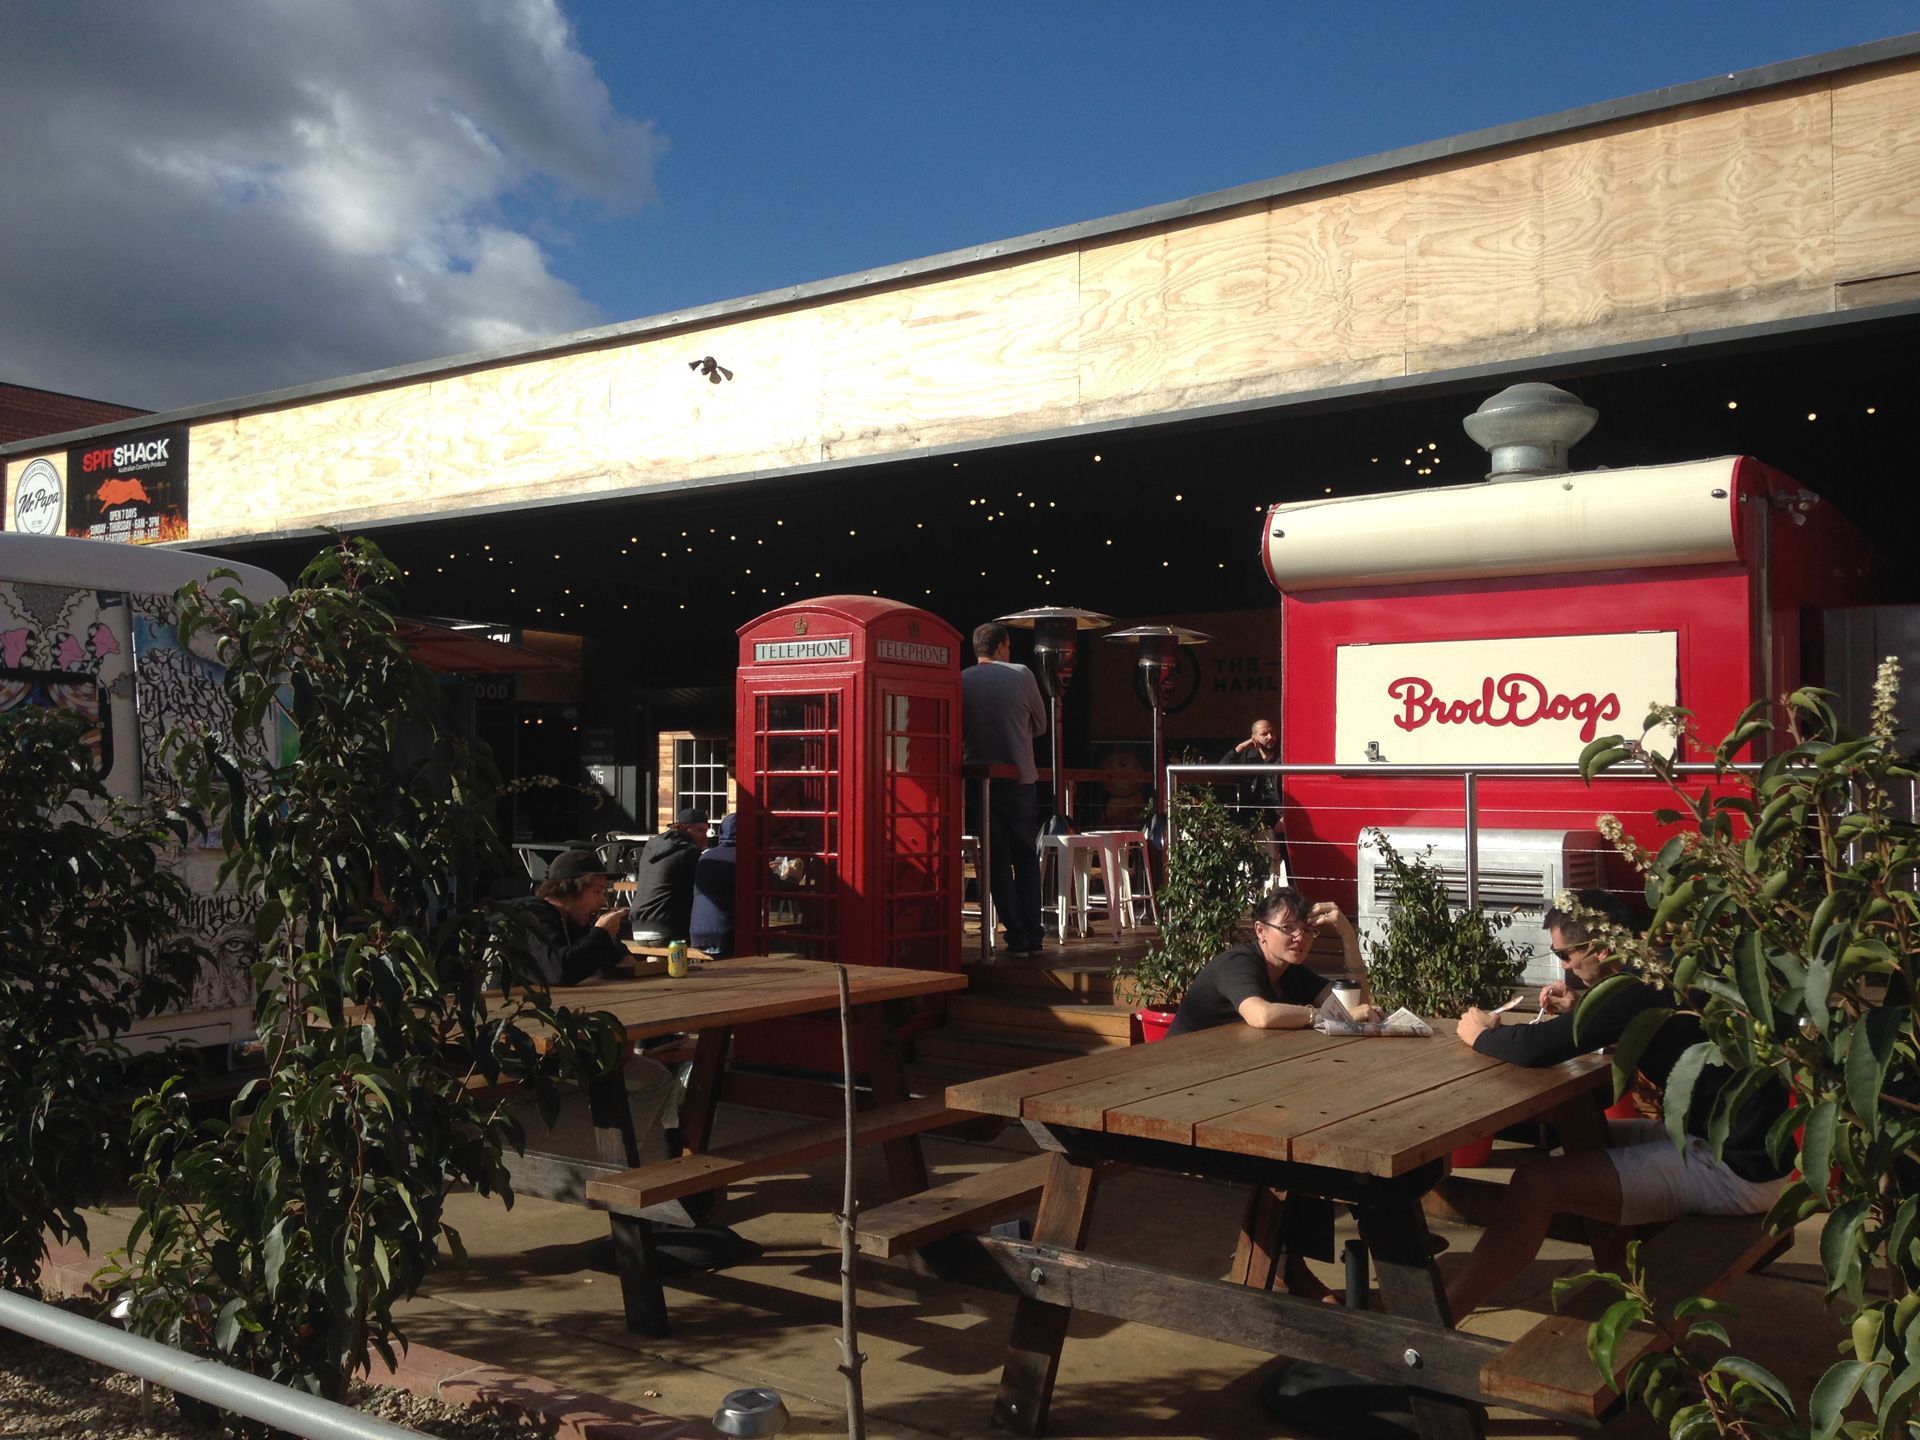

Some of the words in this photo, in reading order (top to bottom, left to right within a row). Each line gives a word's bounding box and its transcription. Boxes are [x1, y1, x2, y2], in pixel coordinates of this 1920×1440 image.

[35, 489, 59, 514] Papa
[109, 510, 122, 521] OPEN
[125, 508, 137, 519] DAYS
[90, 523, 107, 535] SUNDAY
[109, 519, 132, 533] THURSDAY
[147, 527, 160, 539] LATE
[759, 640, 847, 660] TELEPHONE
[878, 640, 945, 663] TELEPHONE
